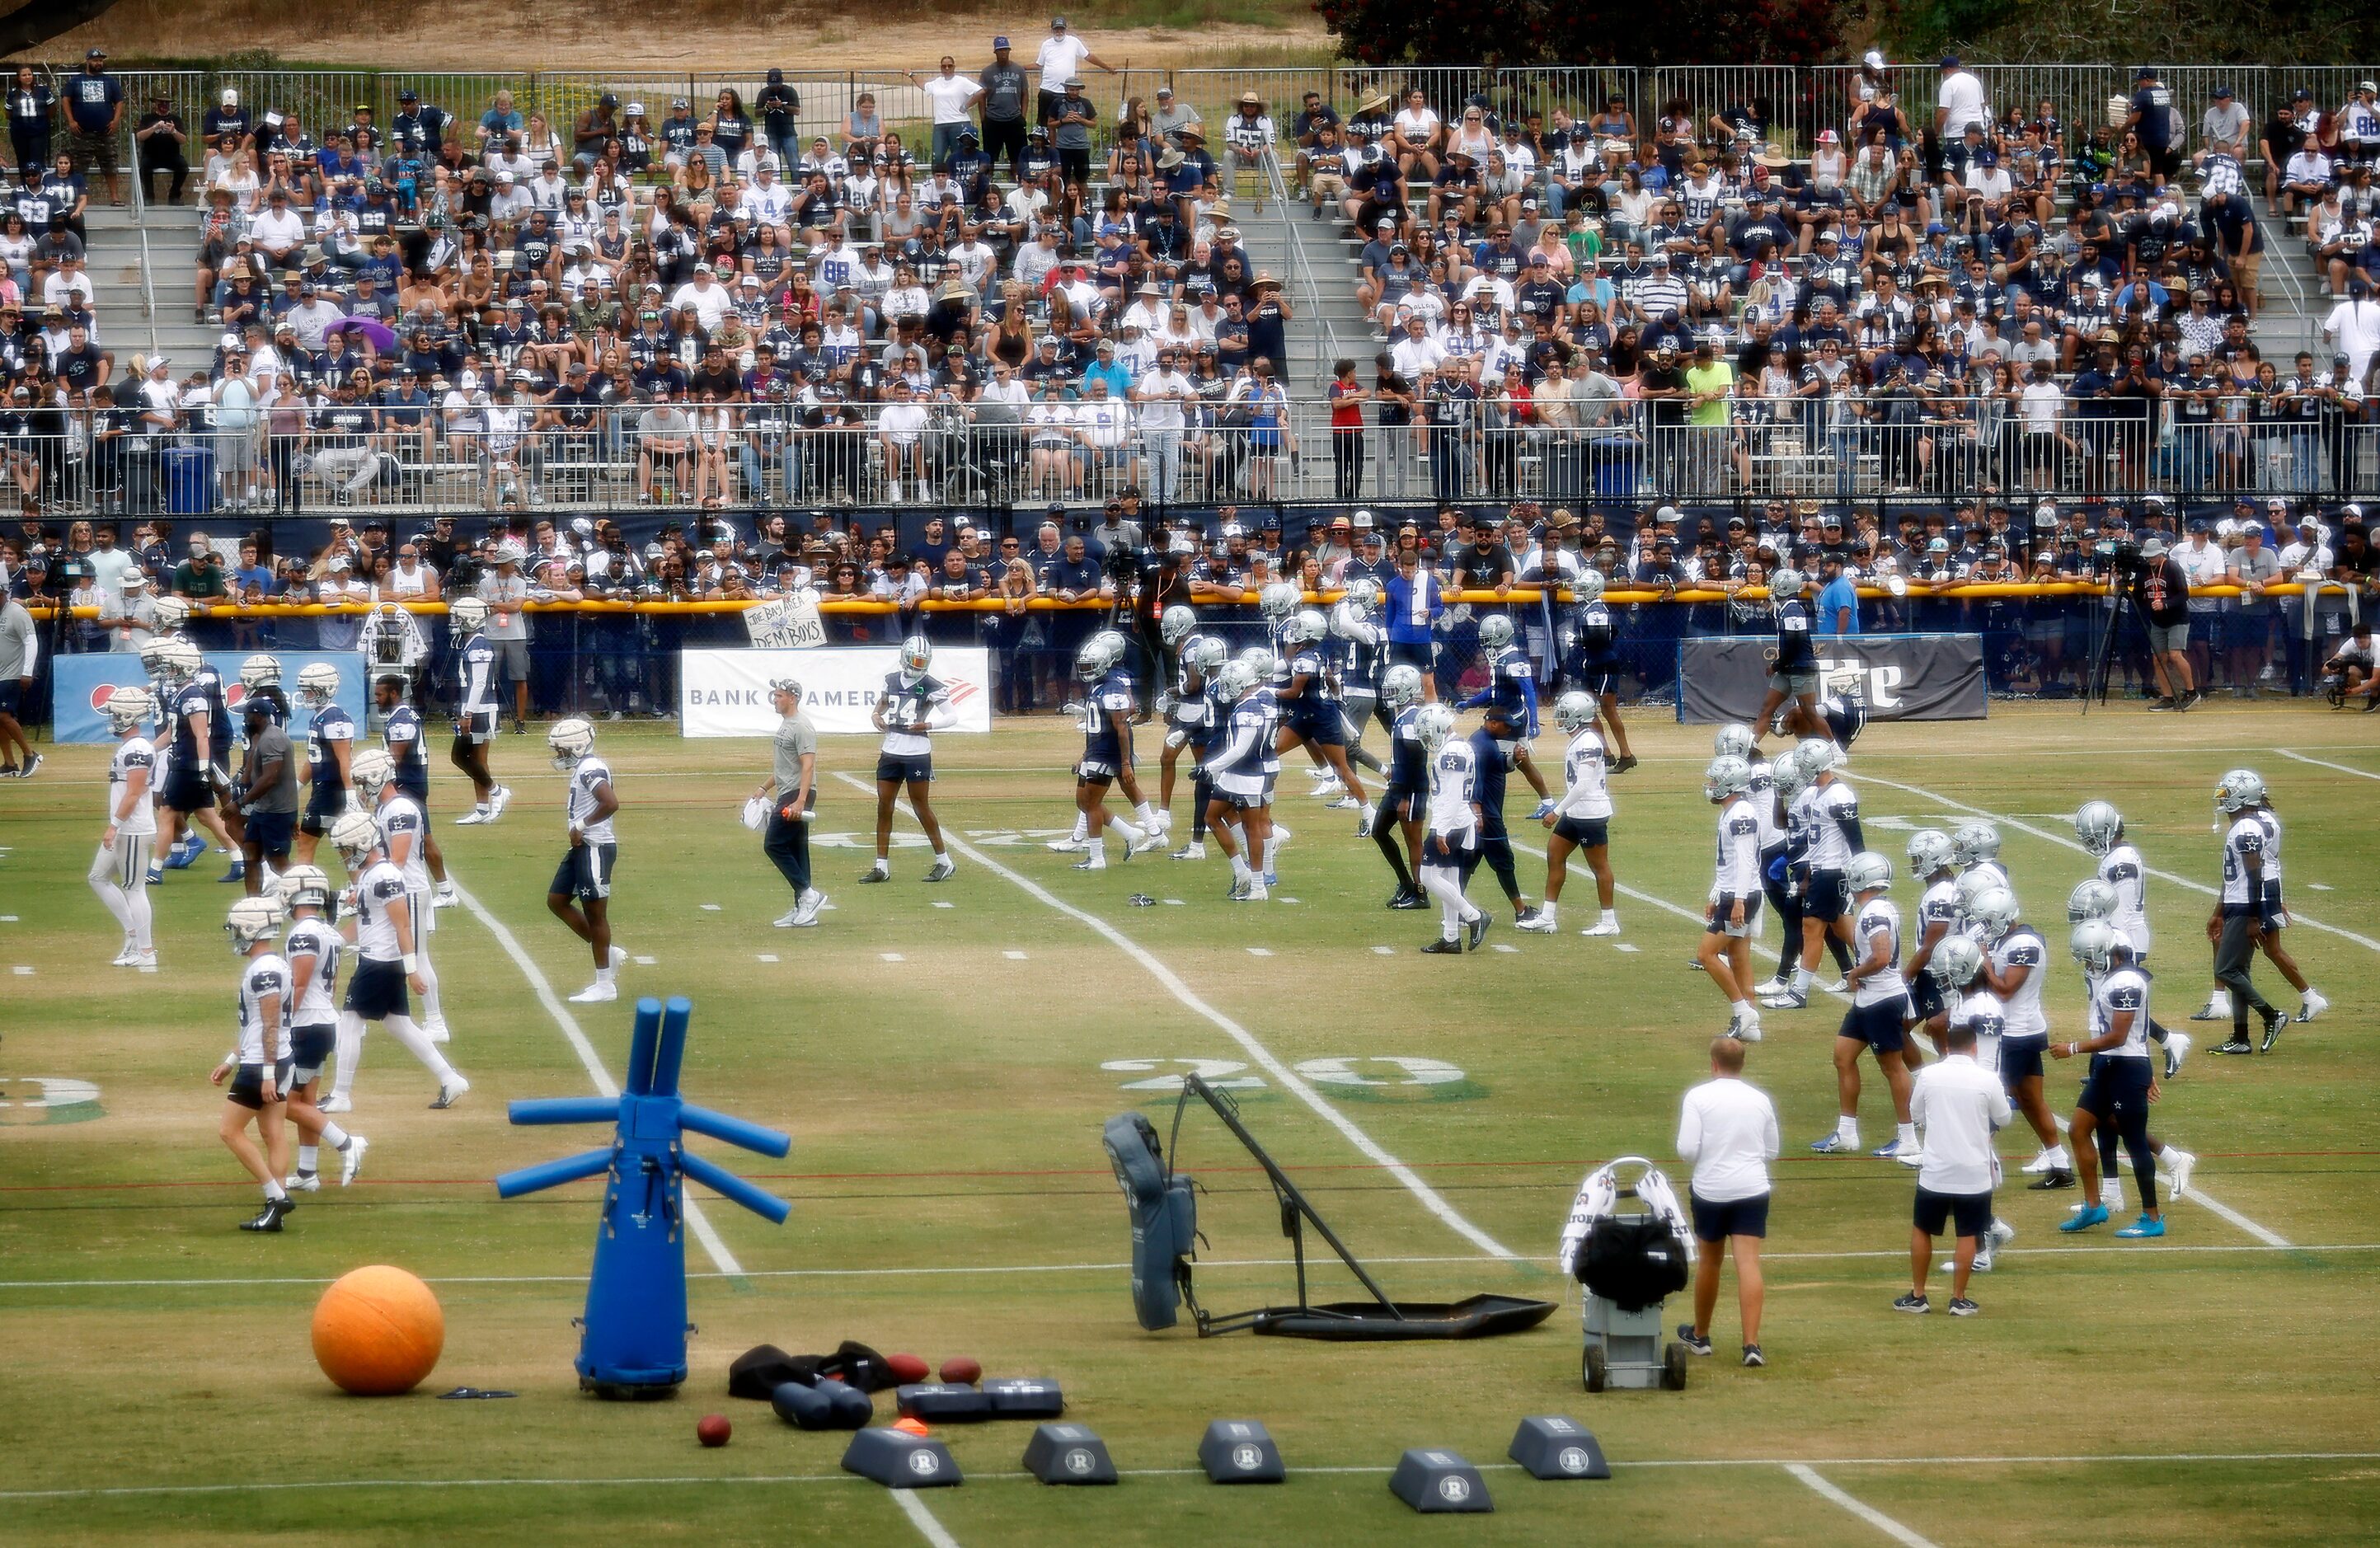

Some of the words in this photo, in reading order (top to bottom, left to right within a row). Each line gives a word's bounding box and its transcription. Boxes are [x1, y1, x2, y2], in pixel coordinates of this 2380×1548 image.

[20, 97, 38, 117] 11
[719, 120, 740, 129] DALLAS
[2356, 116, 2378, 137] 88
[599, 190, 618, 205] 21
[1687, 196, 1713, 218] 88
[17, 199, 51, 224] 63
[764, 199, 777, 218] 4
[1744, 227, 1773, 240] COWBOYS
[523, 242, 549, 252] COWBOYS
[756, 256, 780, 264] DALLAS
[824, 260, 850, 284] 88
[353, 299, 381, 315] COWBOYS
[1771, 293, 1781, 317] 4
[1446, 337, 1476, 355] 94
[324, 370, 344, 391] 11
[861, 368, 873, 387] 4
[333, 415, 363, 425] COWBOYS
[764, 604, 783, 621] BAY
[783, 595, 805, 613] AREA
[690, 690, 759, 706] BANK
[888, 696, 919, 726] 24
